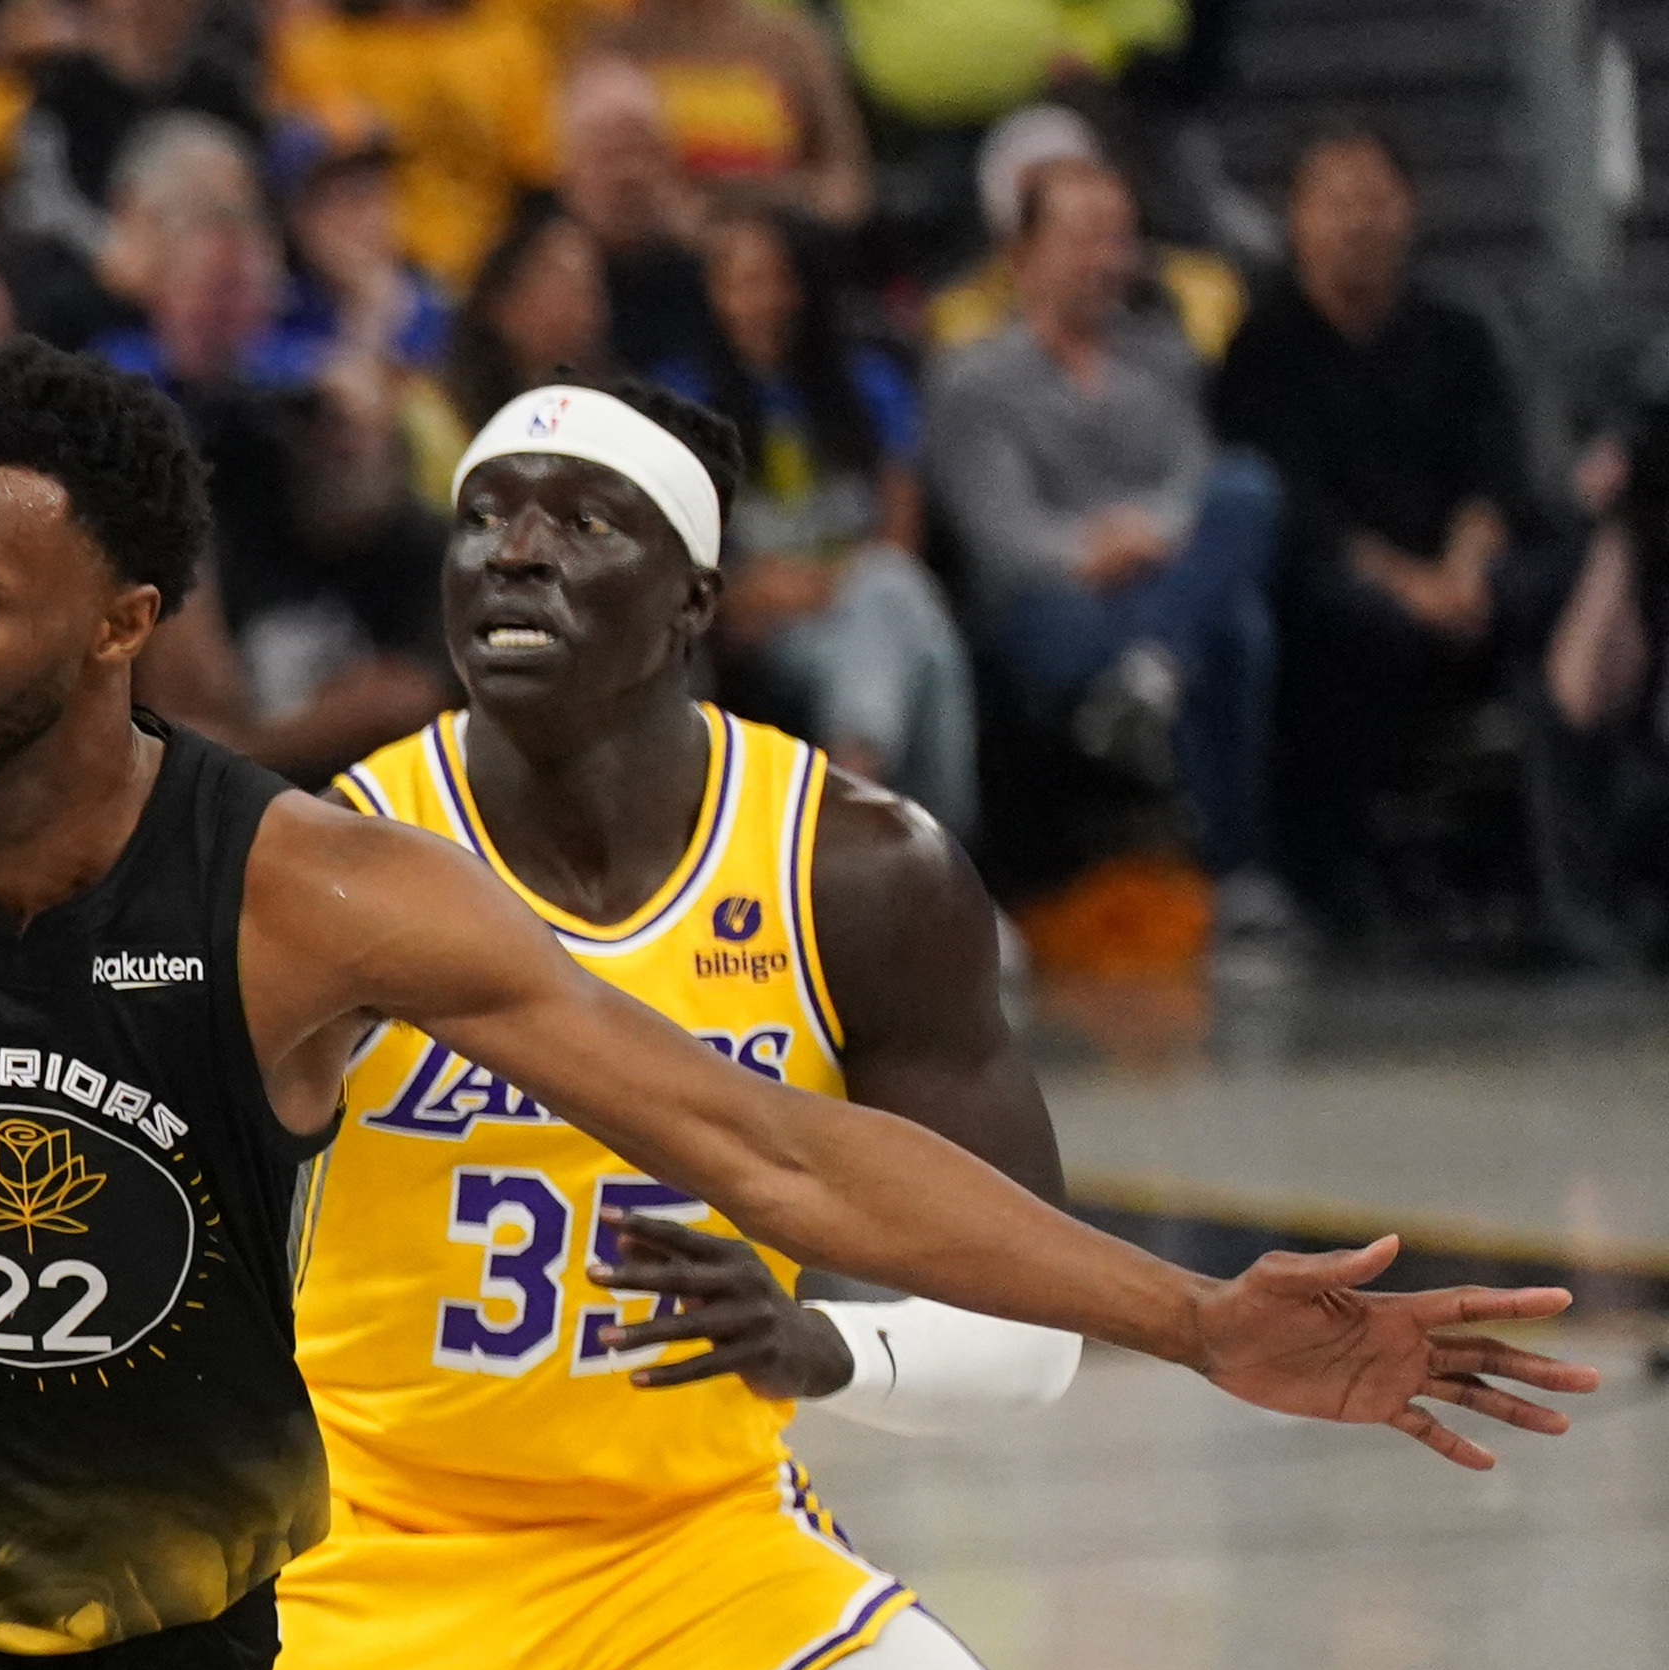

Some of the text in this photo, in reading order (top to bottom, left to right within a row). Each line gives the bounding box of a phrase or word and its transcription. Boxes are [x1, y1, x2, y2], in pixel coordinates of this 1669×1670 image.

[92, 950, 204, 985] Rakuten
[694, 950, 788, 983] bibigo
[359, 1022, 794, 1142] LAS
